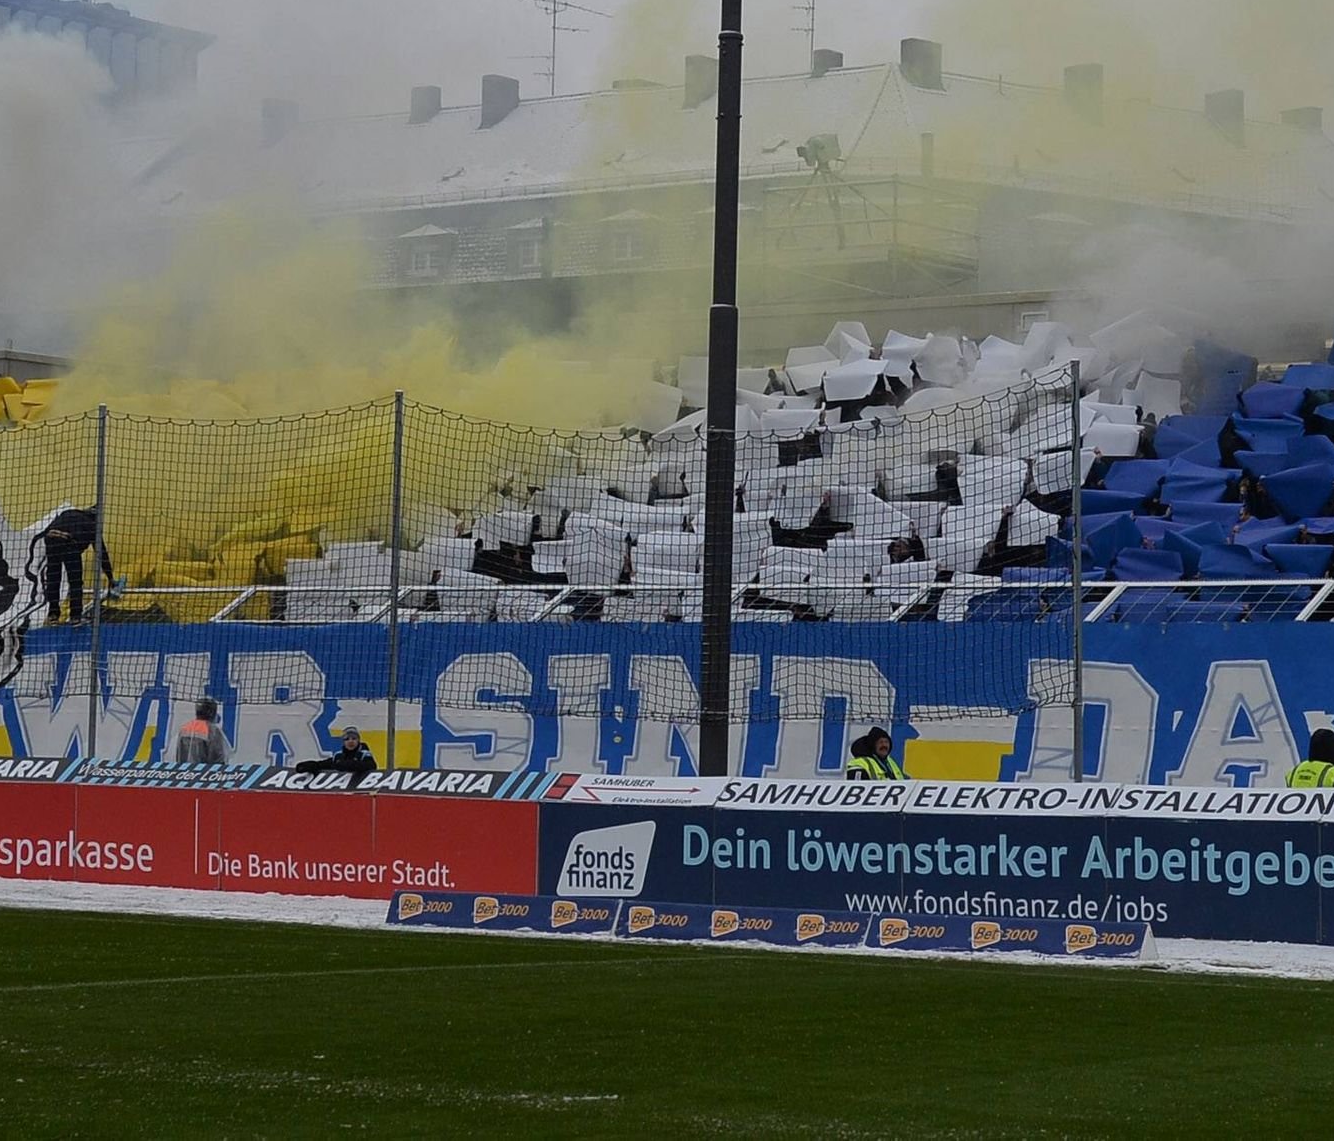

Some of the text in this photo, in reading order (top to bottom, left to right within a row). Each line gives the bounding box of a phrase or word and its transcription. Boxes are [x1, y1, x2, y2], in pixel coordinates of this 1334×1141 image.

[11, 650, 331, 767] WIR
[435, 652, 896, 779] SIND
[78, 763, 246, 782] Wasserpartner der Löwen
[261, 770, 494, 794] AQUA BAVARIA
[592, 778, 655, 787] SAMHUBER
[717, 782, 906, 807] SAMHUBER
[573, 844, 635, 871] fonds
[682, 824, 771, 870] Dein
[787, 829, 1068, 878] löwenstarker
[208, 853, 456, 888] Die Bank unserer Stadt.
[567, 863, 635, 890] finanz
[844, 889, 1168, 922] www.fondsfinanz.de/jobs
